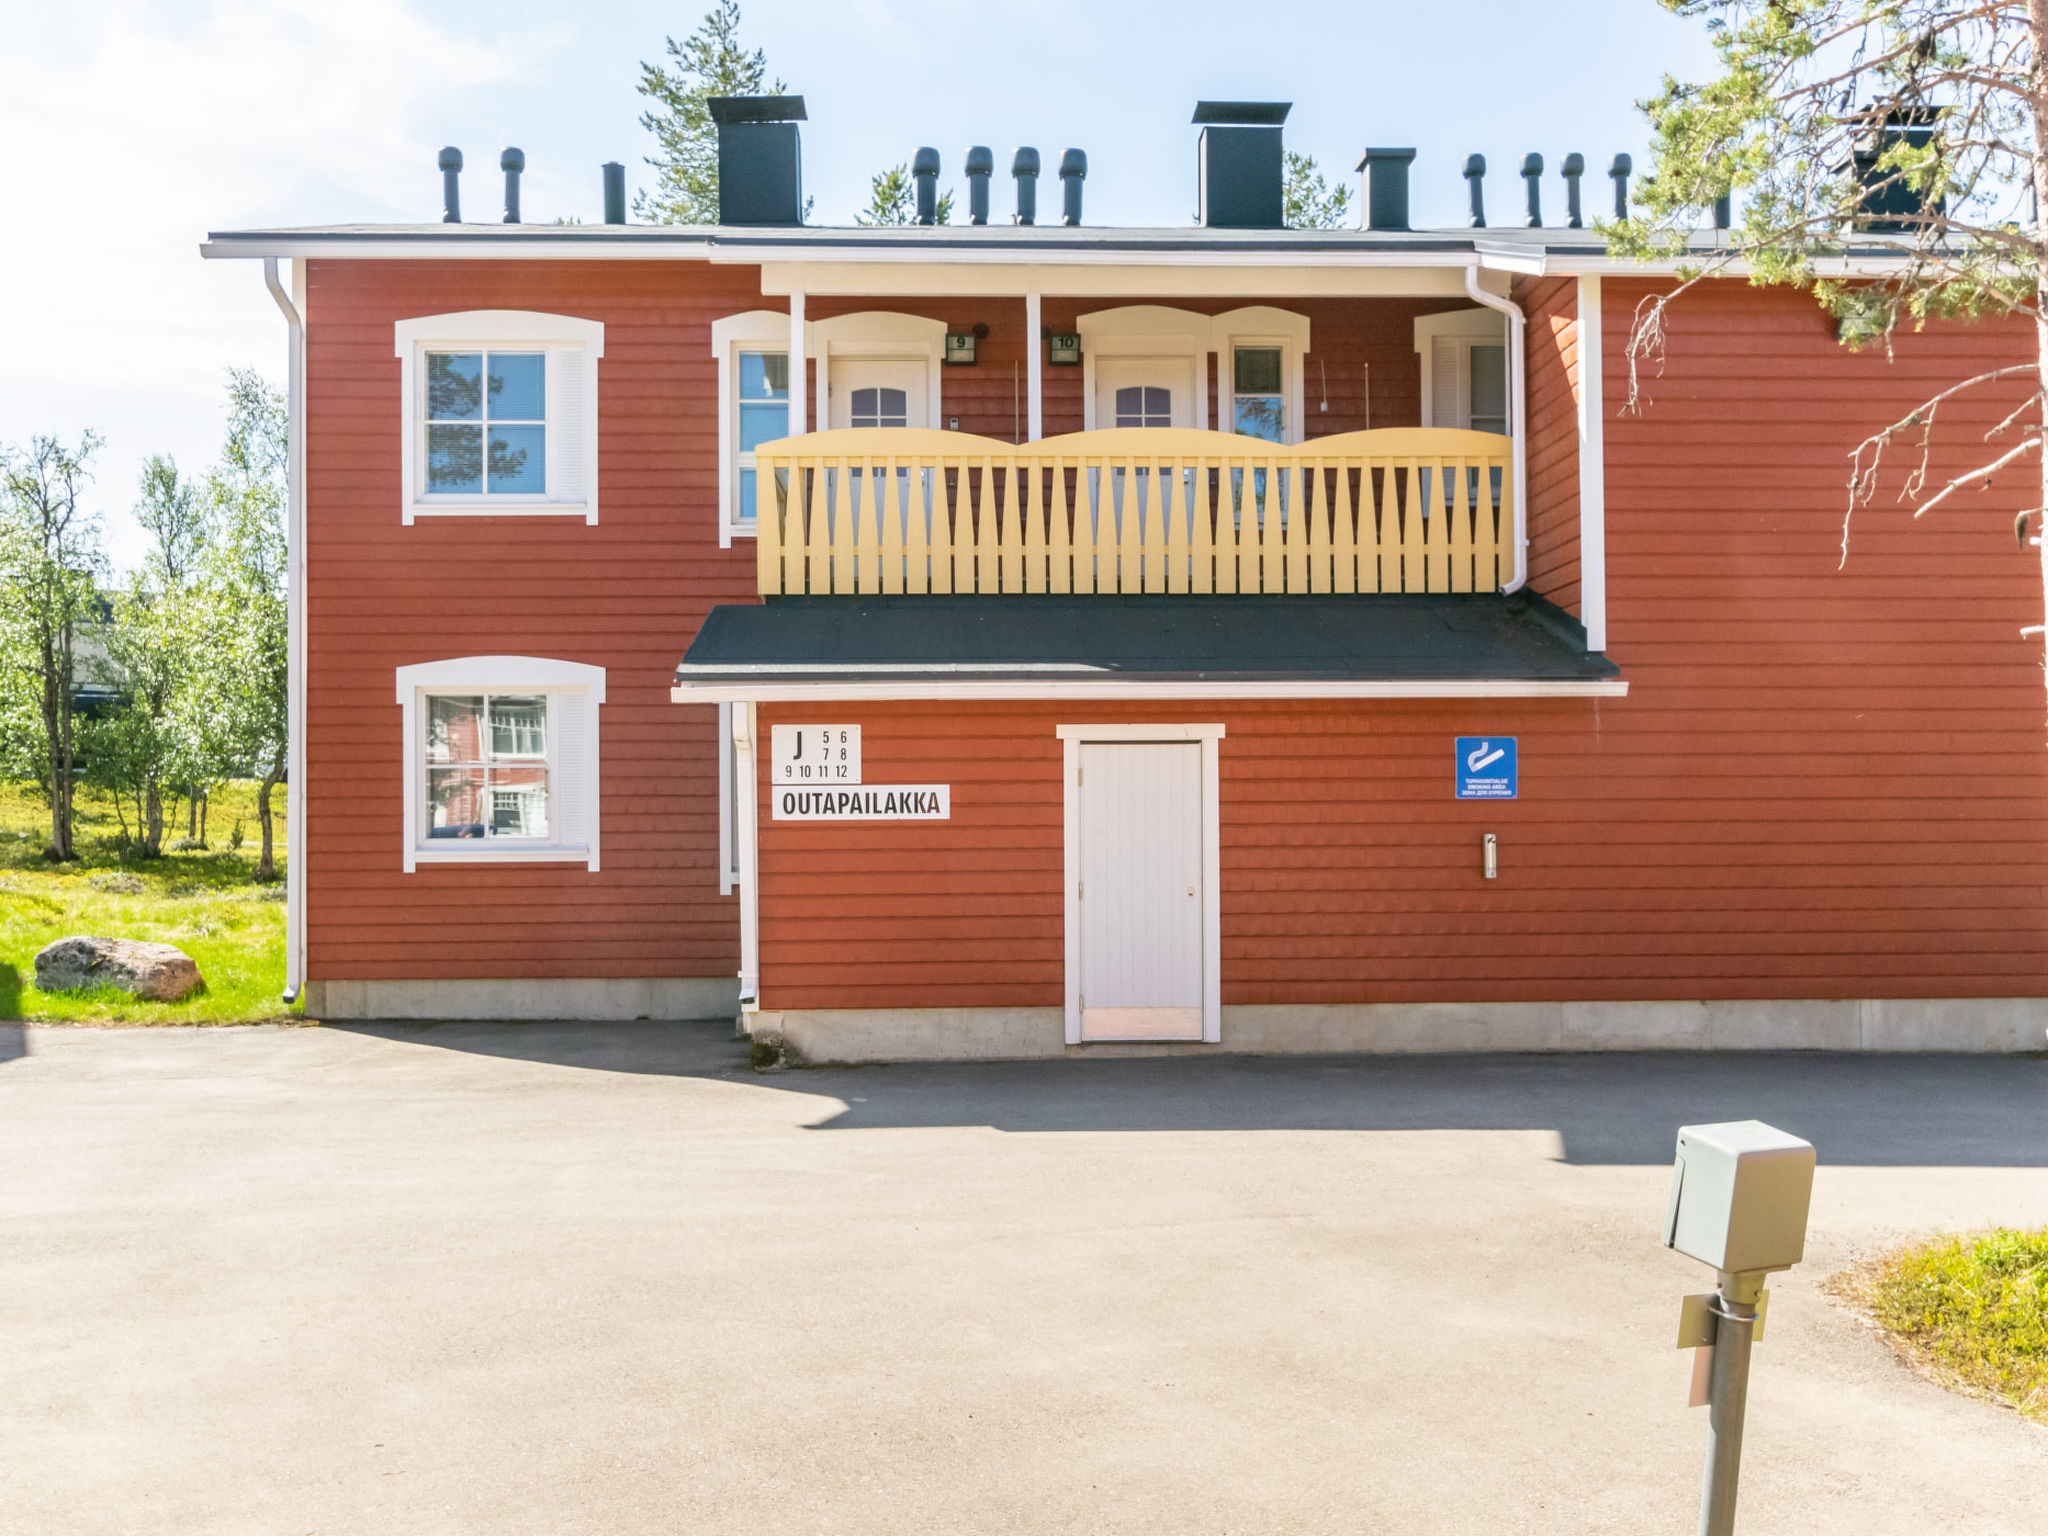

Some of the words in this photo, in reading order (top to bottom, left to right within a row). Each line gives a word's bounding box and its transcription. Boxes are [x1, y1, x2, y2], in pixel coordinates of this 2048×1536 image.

[956, 337, 966, 348] 9
[1058, 337, 1074, 348] 10
[822, 731, 829, 744] 5
[840, 731, 847, 744] 6
[793, 731, 802, 760] J
[822, 748, 829, 760] 7
[840, 748, 847, 760] 8
[785, 765, 792, 778] 9
[799, 765, 811, 778] 10
[819, 765, 828, 778] 11
[836, 765, 847, 778] 12
[783, 792, 941, 815] OUTAPAILAKKA
